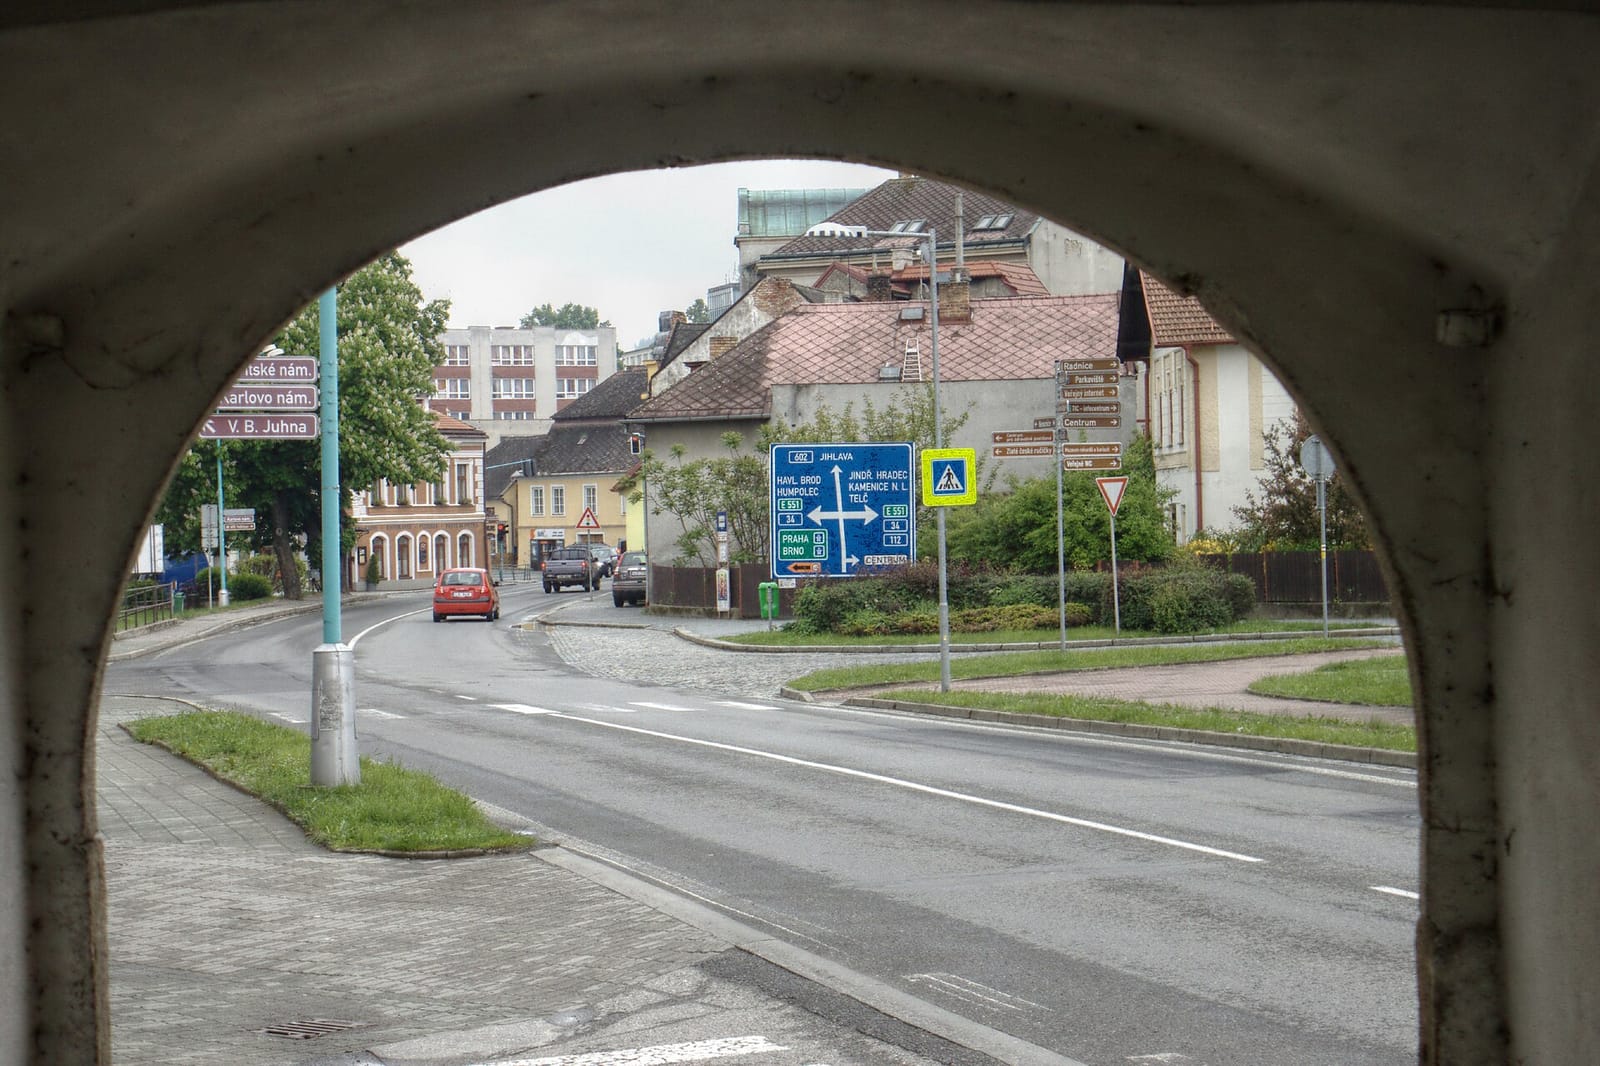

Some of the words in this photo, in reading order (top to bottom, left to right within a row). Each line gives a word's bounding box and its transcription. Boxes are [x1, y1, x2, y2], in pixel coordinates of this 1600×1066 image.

[280, 362, 312, 376] nám.
[277, 390, 312, 404] nám.
[227, 419, 239, 433] V.
[244, 420, 258, 432] B.
[263, 420, 306, 433] Juhna
[794, 453, 808, 461] 602
[820, 452, 853, 461] JIHLAVA
[876, 471, 908, 479] HRADEC
[800, 476, 821, 484] BROD
[848, 482, 889, 491] KAMENICE
[777, 488, 819, 496] HUMPOLEC
[849, 492, 868, 502] TELČ
[786, 515, 795, 523] 34
[890, 522, 900, 530] 34
[782, 534, 808, 543] PRAHA
[890, 536, 901, 544] 112
[782, 547, 804, 555] BRNO
[865, 556, 906, 564] CENTRUM
